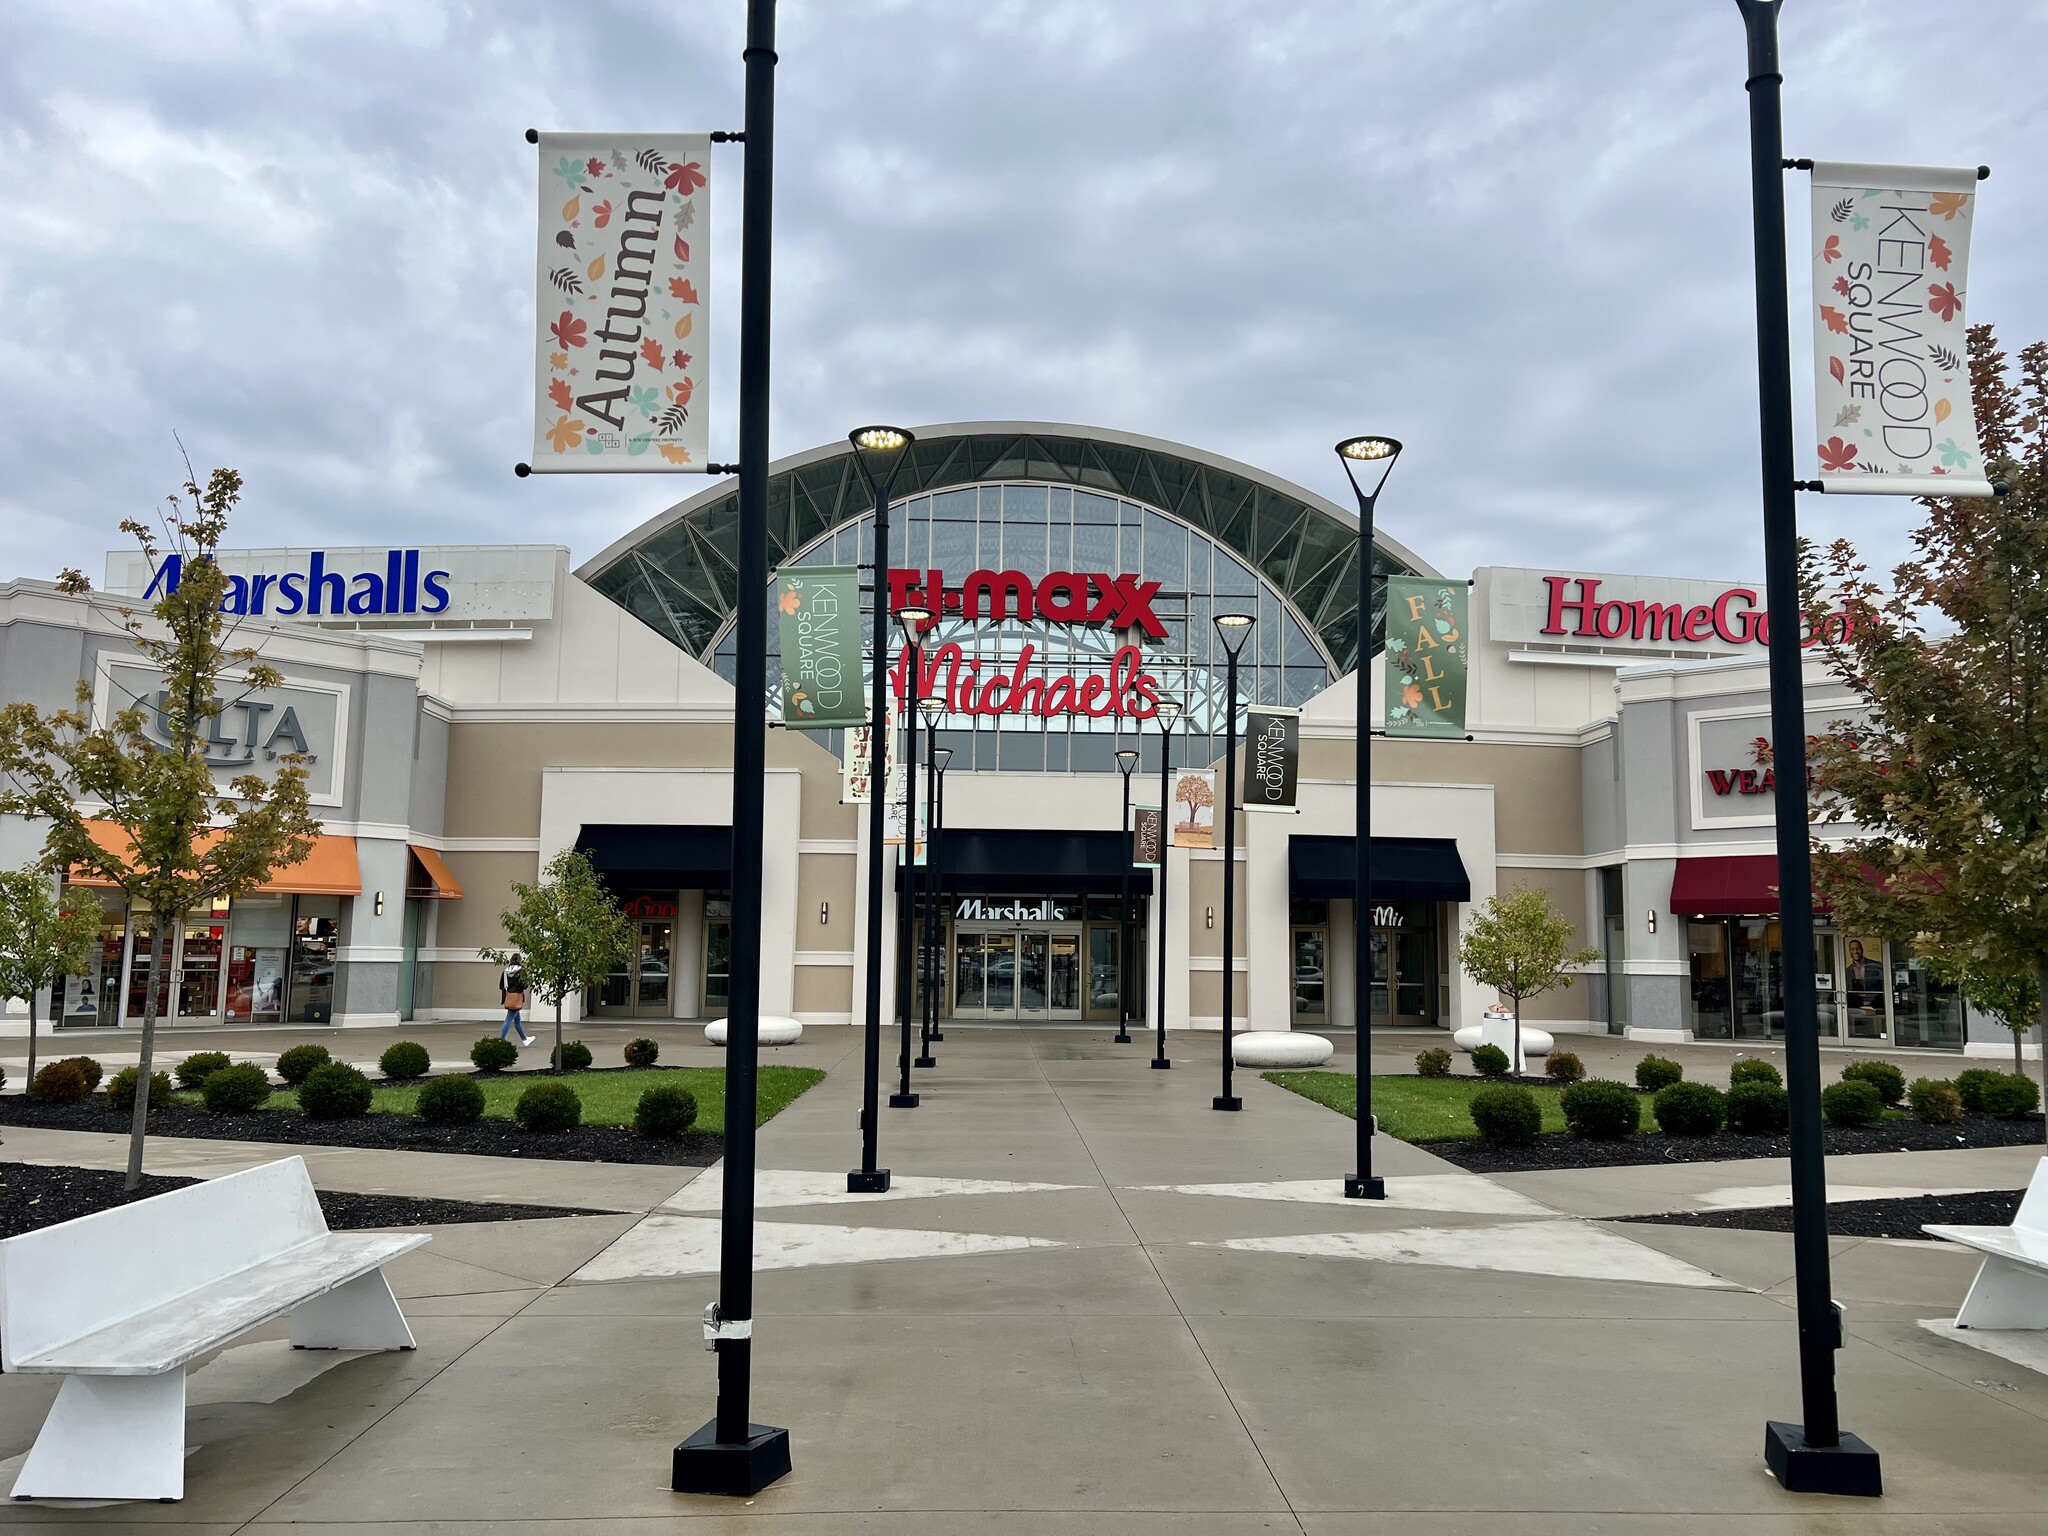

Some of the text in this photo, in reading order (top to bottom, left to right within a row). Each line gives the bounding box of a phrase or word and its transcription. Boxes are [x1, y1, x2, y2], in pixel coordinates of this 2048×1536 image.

[576, 190, 666, 431] Autumn
[1848, 261, 1876, 400] SQUARE
[1877, 206, 1932, 460] KENWOOD
[797, 611, 815, 680] SQUARE
[811, 583, 844, 710] KENWOOD
[1540, 576, 1881, 648] HomeGd
[889, 642, 1161, 719] Michaels
[1405, 594, 1453, 712] FALL
[203, 744, 318, 764] BEAUY
[1256, 734, 1267, 780] SQUARE
[1265, 717, 1285, 801] KENWOOD
[1140, 821, 1148, 849] SQUARE
[1145, 811, 1158, 861] KENWOOD
[956, 899, 1064, 920] Marshalls
